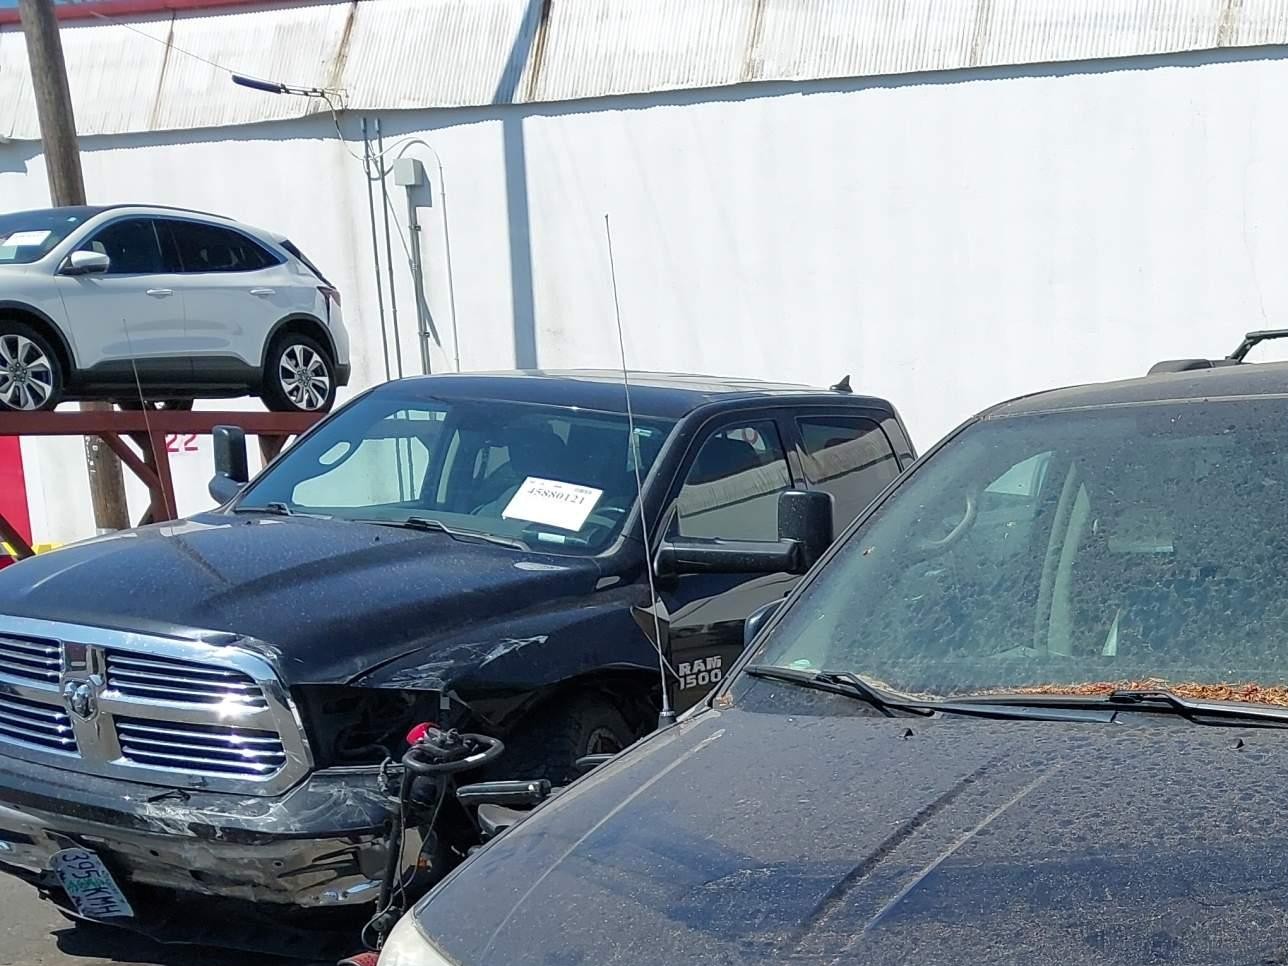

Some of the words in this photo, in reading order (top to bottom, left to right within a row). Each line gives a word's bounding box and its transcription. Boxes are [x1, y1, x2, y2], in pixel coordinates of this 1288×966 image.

[678, 655, 722, 677] RAM
[679, 669, 722, 690] 1500
[62, 852, 101, 880] 395
[81, 886, 121, 915] KMH
